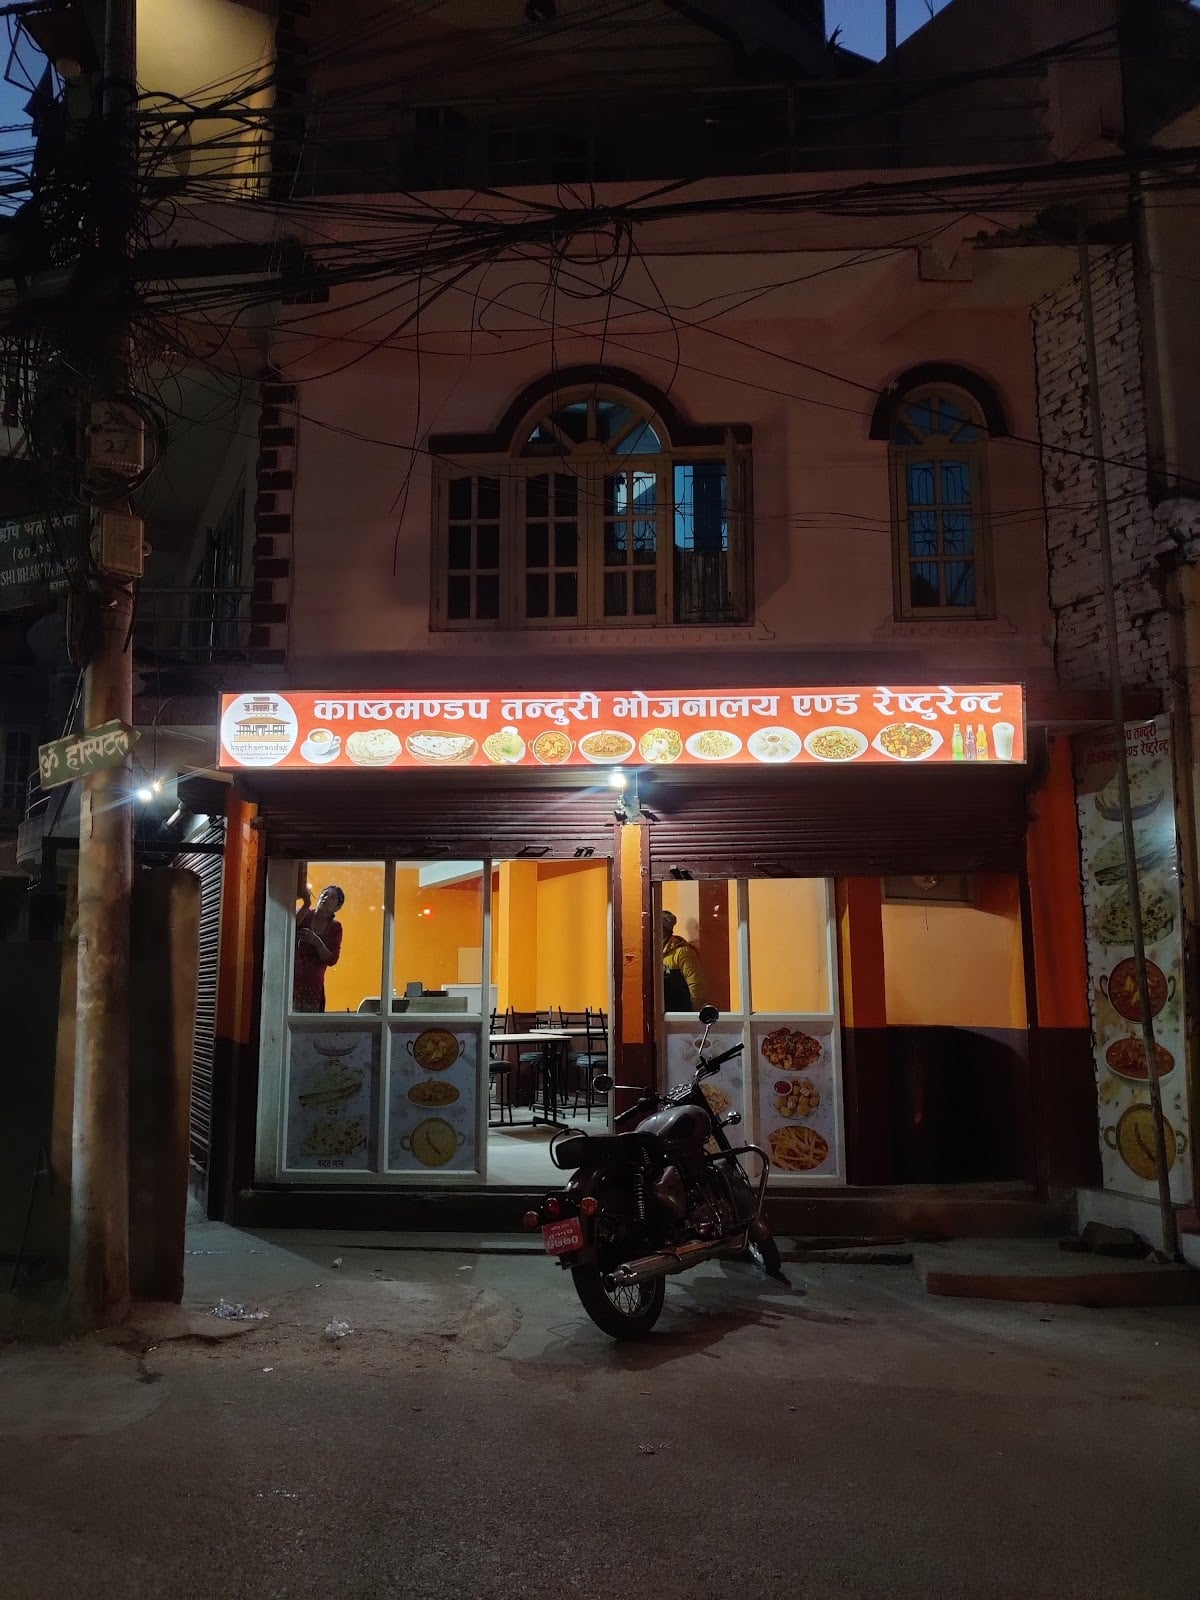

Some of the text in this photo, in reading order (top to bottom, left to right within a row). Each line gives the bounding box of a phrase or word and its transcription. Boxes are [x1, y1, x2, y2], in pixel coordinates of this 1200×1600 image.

[314, 686, 1003, 725] काष्ठमण्डप तन्दुरी भोजनालय एण्ड रेष्टुरेन्ट
